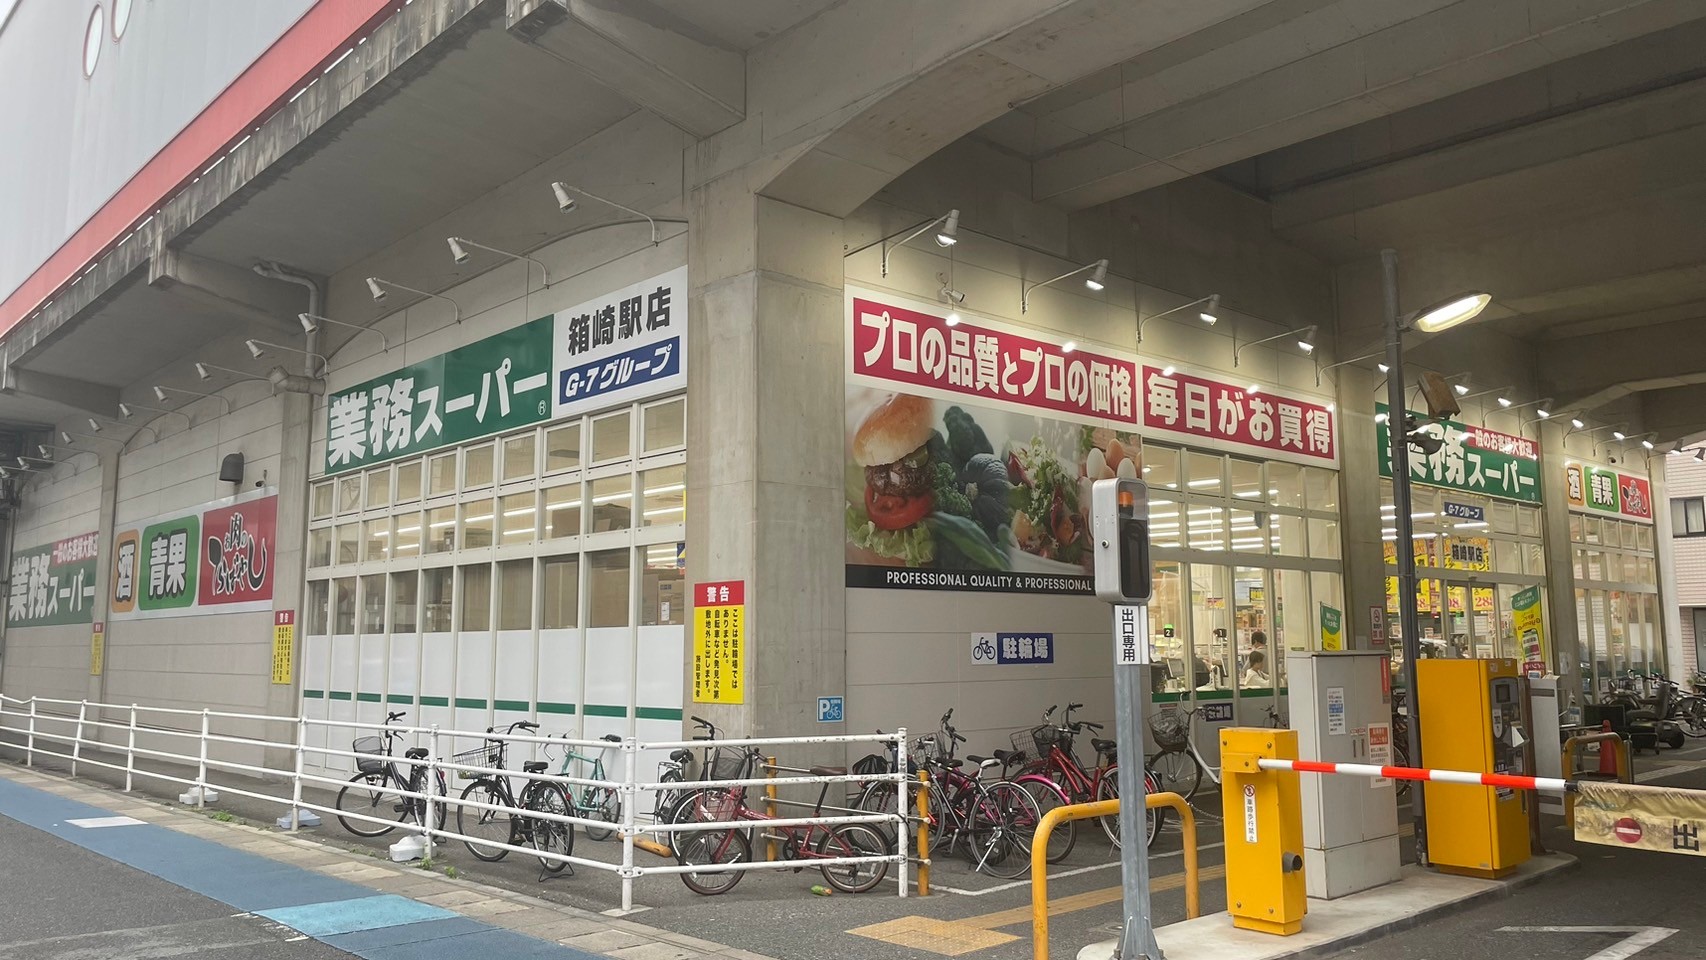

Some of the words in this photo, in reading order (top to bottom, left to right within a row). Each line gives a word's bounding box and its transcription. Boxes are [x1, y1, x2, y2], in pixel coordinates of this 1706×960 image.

[568, 286, 672, 356] 箱崎駅店
[565, 343, 673, 398] G-7グループ
[860, 310, 1133, 419] プロの品質とプロの価格
[328, 358, 548, 467] 業務スーパー
[1148, 371, 1331, 455] 毎日がお買得
[1567, 468, 1582, 501] 酒
[1590, 473, 1614, 507] 青果
[117, 541, 136, 600] 酒
[148, 530, 188, 597] 青果
[886, 571, 967, 587] PROFESSIONAL
[970, 575, 1012, 589] QUALITY
[1015, 577, 1022, 588] &
[1025, 577, 1092, 591] PROFESSIONAL
[1452, 543, 1483, 563] 箱崎駅店
[9, 553, 95, 621] 業務スーパー
[706, 586, 730, 603] 警告
[704, 609, 712, 694] 敷地外に出します。
[713, 609, 721, 699] 自転車など発見次第
[722, 609, 730, 664] ありません。
[731, 609, 739, 689] ここは駐輪場では
[1002, 637, 1048, 659] 駐輪場
[1122, 608, 1135, 662] 出口専用
[1673, 823, 1700, 852] 出
